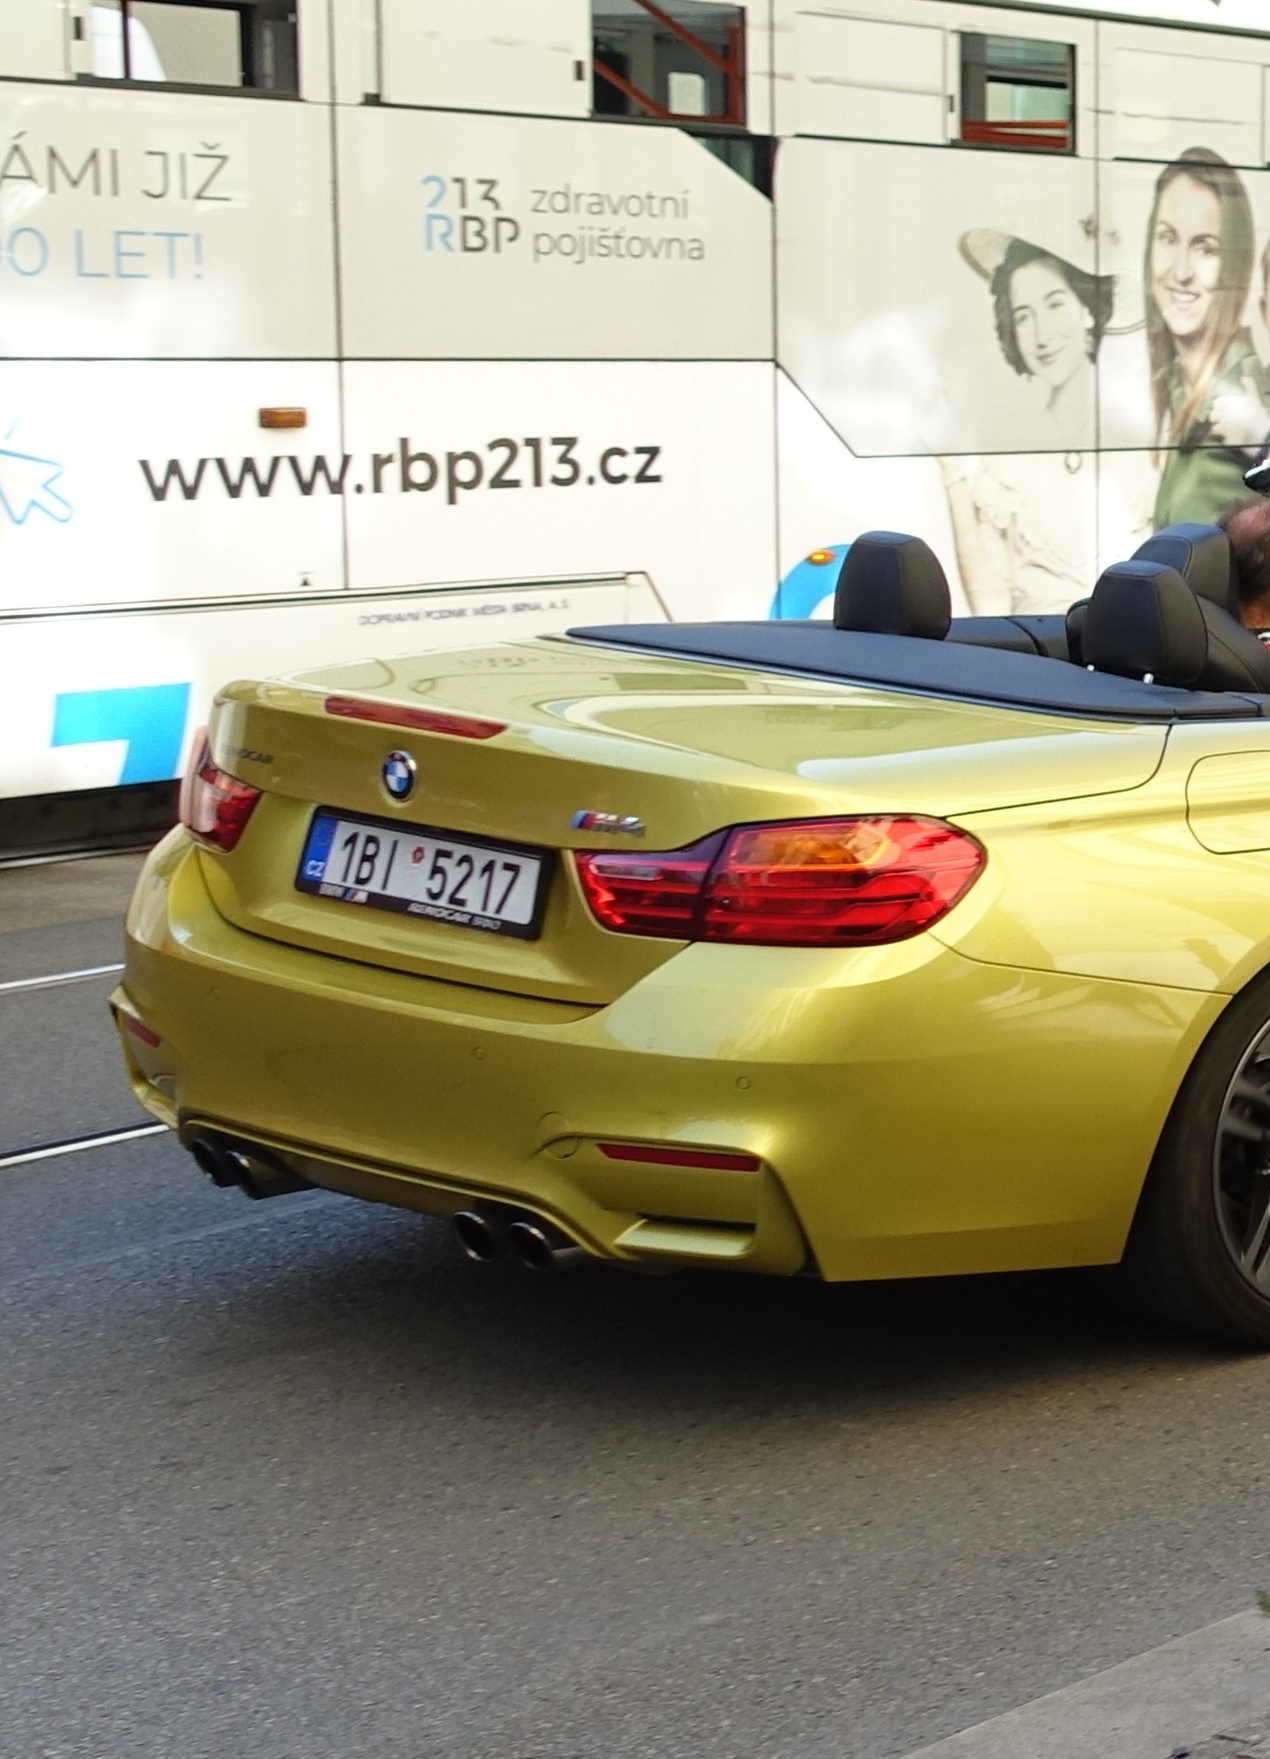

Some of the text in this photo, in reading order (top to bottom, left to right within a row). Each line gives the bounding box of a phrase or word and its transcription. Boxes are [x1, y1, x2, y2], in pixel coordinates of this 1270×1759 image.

[142, 141, 232, 201] JIŽ
[421, 174, 502, 210] 213
[530, 183, 690, 219] zdravotní
[424, 213, 520, 253] RBP
[532, 226, 706, 265] pojišťovna
[74, 229, 204, 280] LET!
[138, 436, 663, 505] www.rbp213.cz
[305, 859, 324, 877] CZ
[341, 831, 522, 915] 1BI 5217
